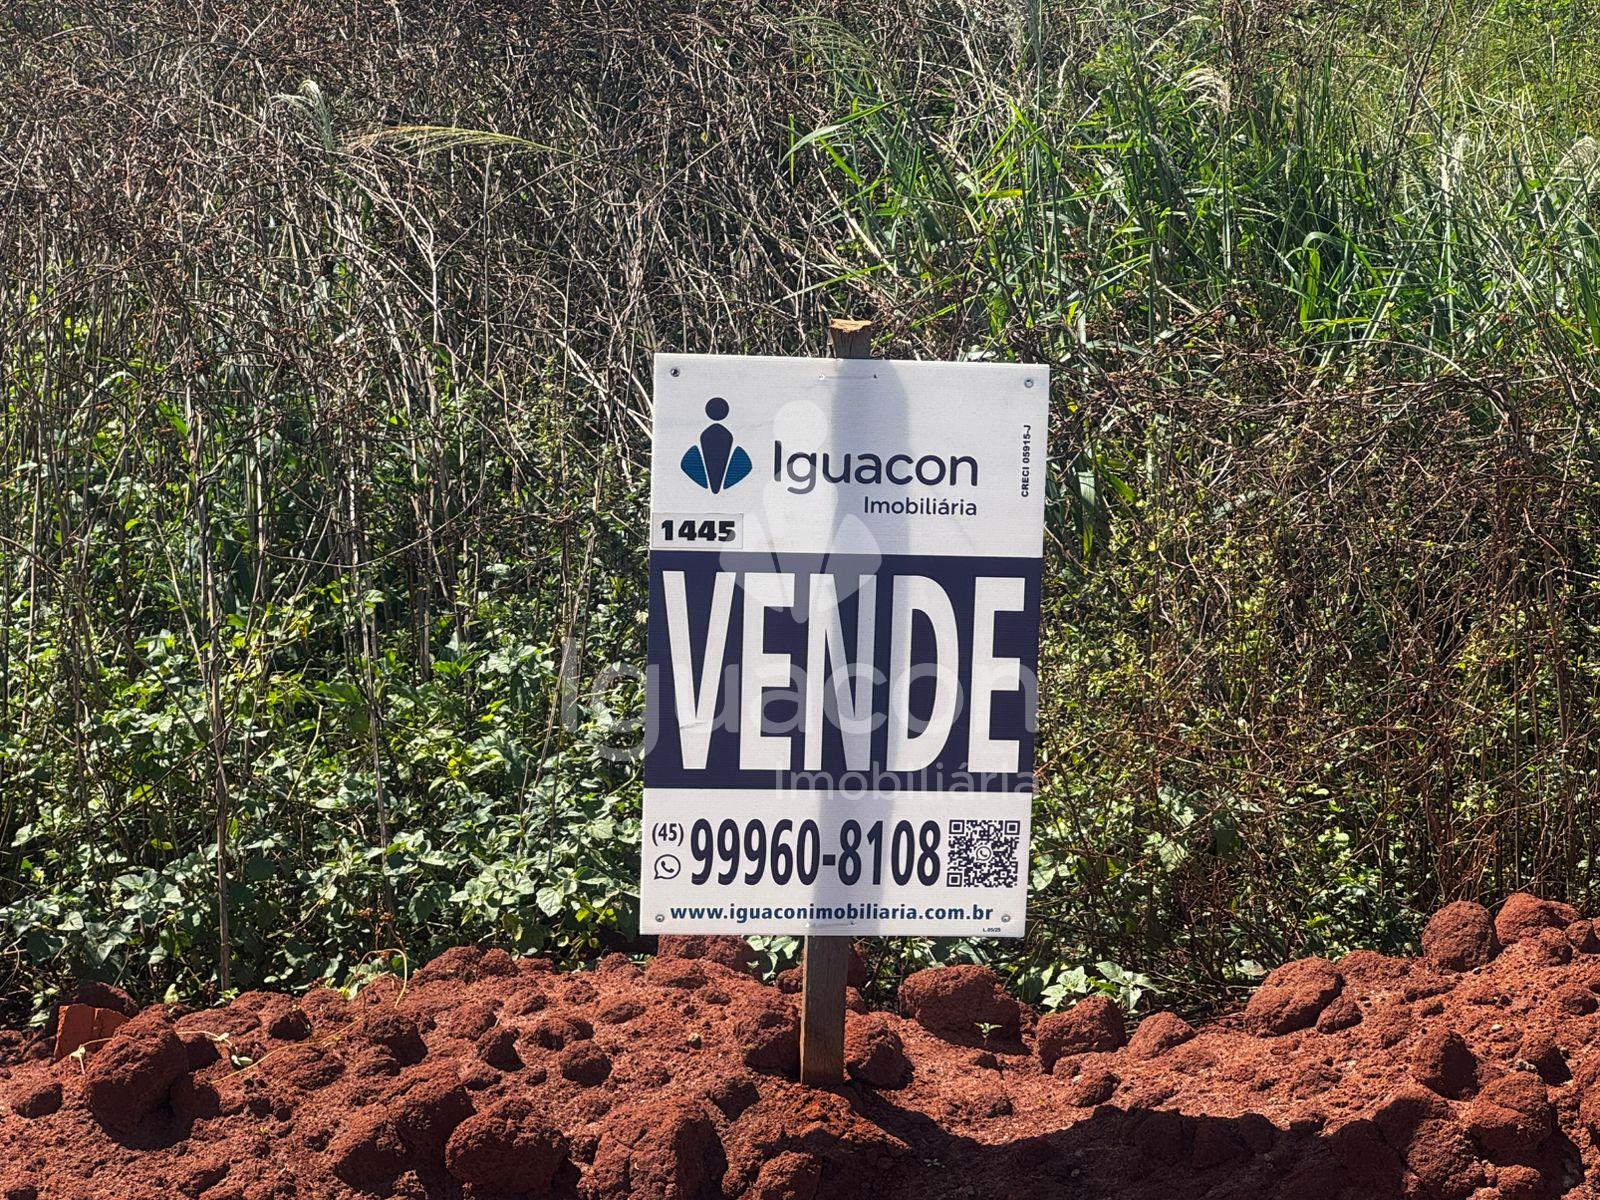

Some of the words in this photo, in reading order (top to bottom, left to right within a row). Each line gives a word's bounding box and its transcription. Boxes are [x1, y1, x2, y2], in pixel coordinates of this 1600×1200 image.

[1022, 424, 1032, 464] 05915-J
[773, 440, 979, 495] Iguacon
[1021, 466, 1030, 497] CRECI
[863, 495, 978, 516] Imobiliária
[661, 519, 736, 542] 1445
[662, 570, 1027, 774] VENDE
[651, 822, 684, 847] (45)
[690, 818, 941, 887] 99960-8108
[670, 902, 994, 924] www.iguaconimobiliaria.com.br
